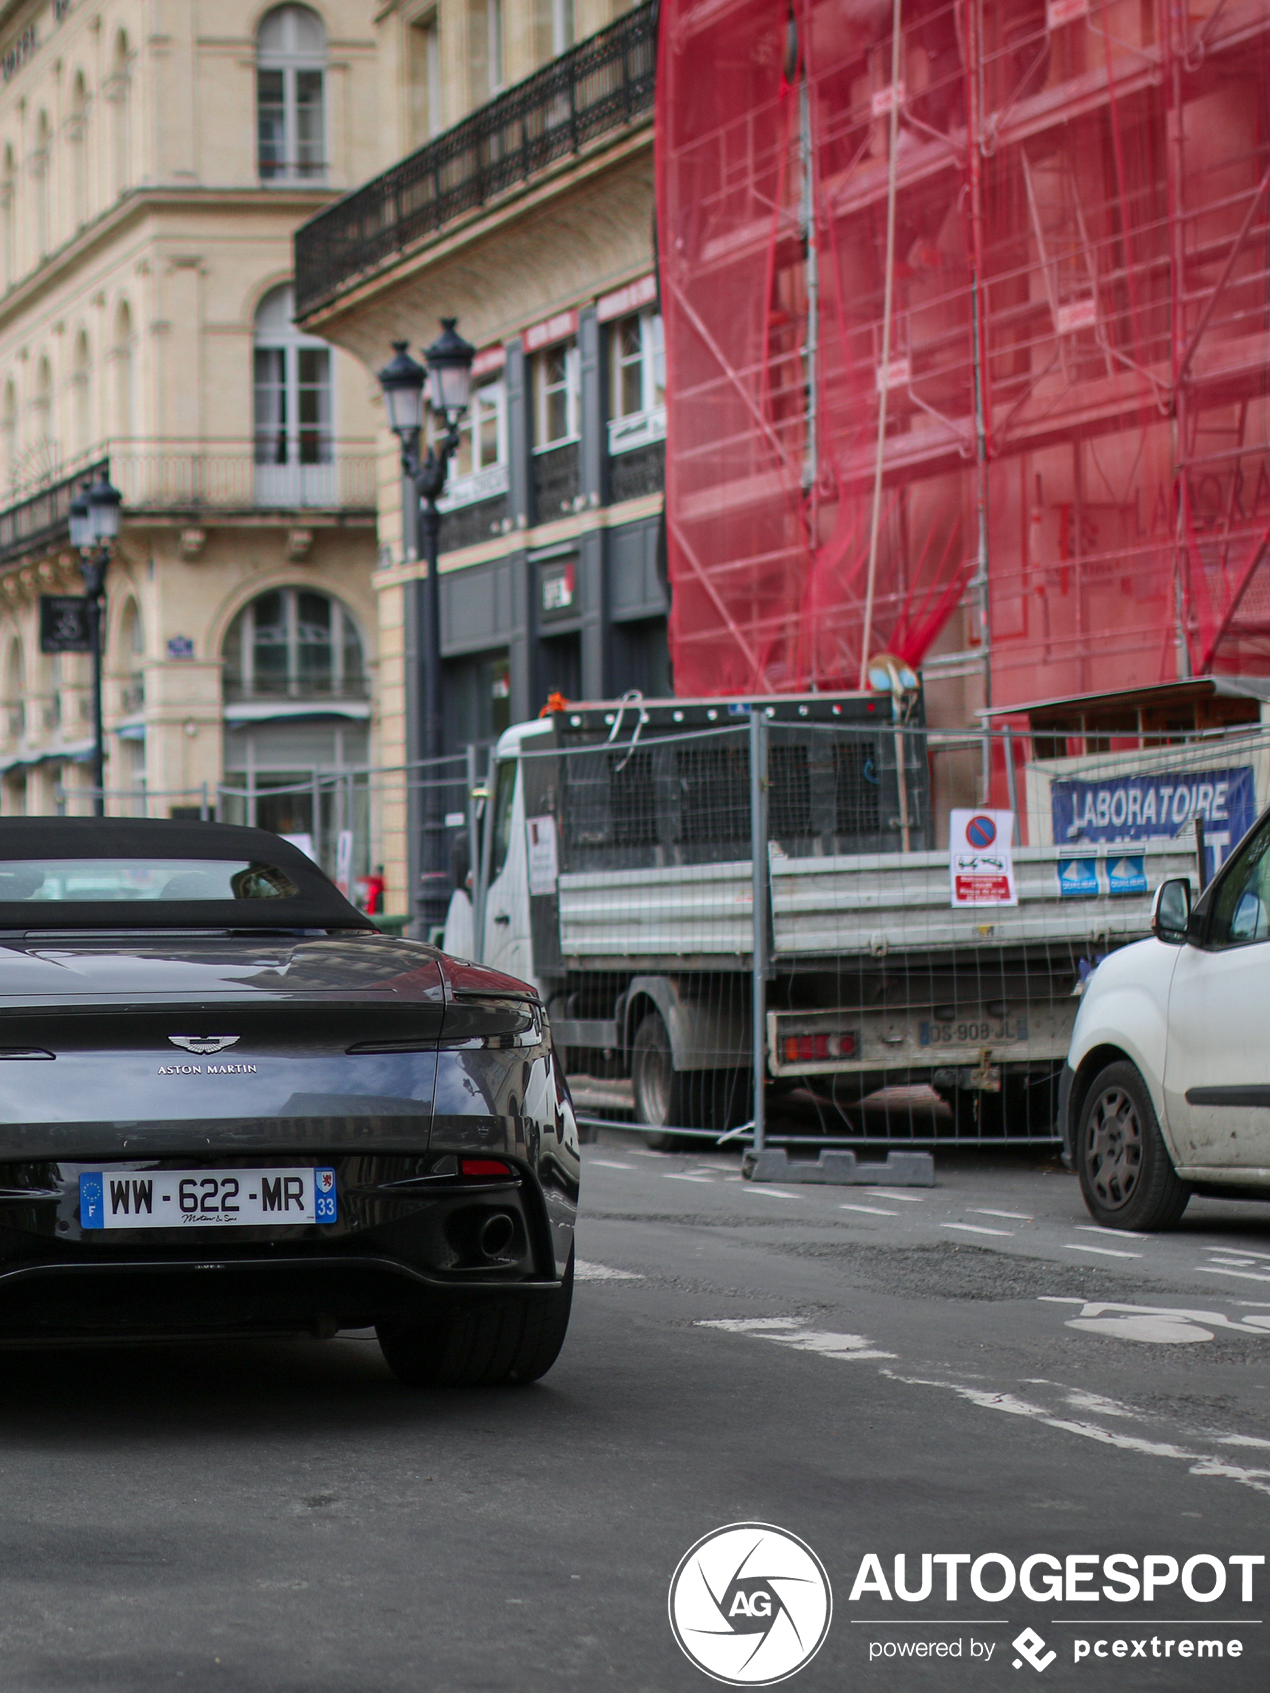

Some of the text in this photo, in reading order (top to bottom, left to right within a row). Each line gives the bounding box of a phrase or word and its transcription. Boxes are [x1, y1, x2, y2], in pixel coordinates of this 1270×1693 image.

[1071, 781, 1230, 829] LABORATOIRE
[158, 1064, 257, 1075] ASTON MARTIN
[89, 1206, 96, 1217] F
[317, 1198, 335, 1216] 33
